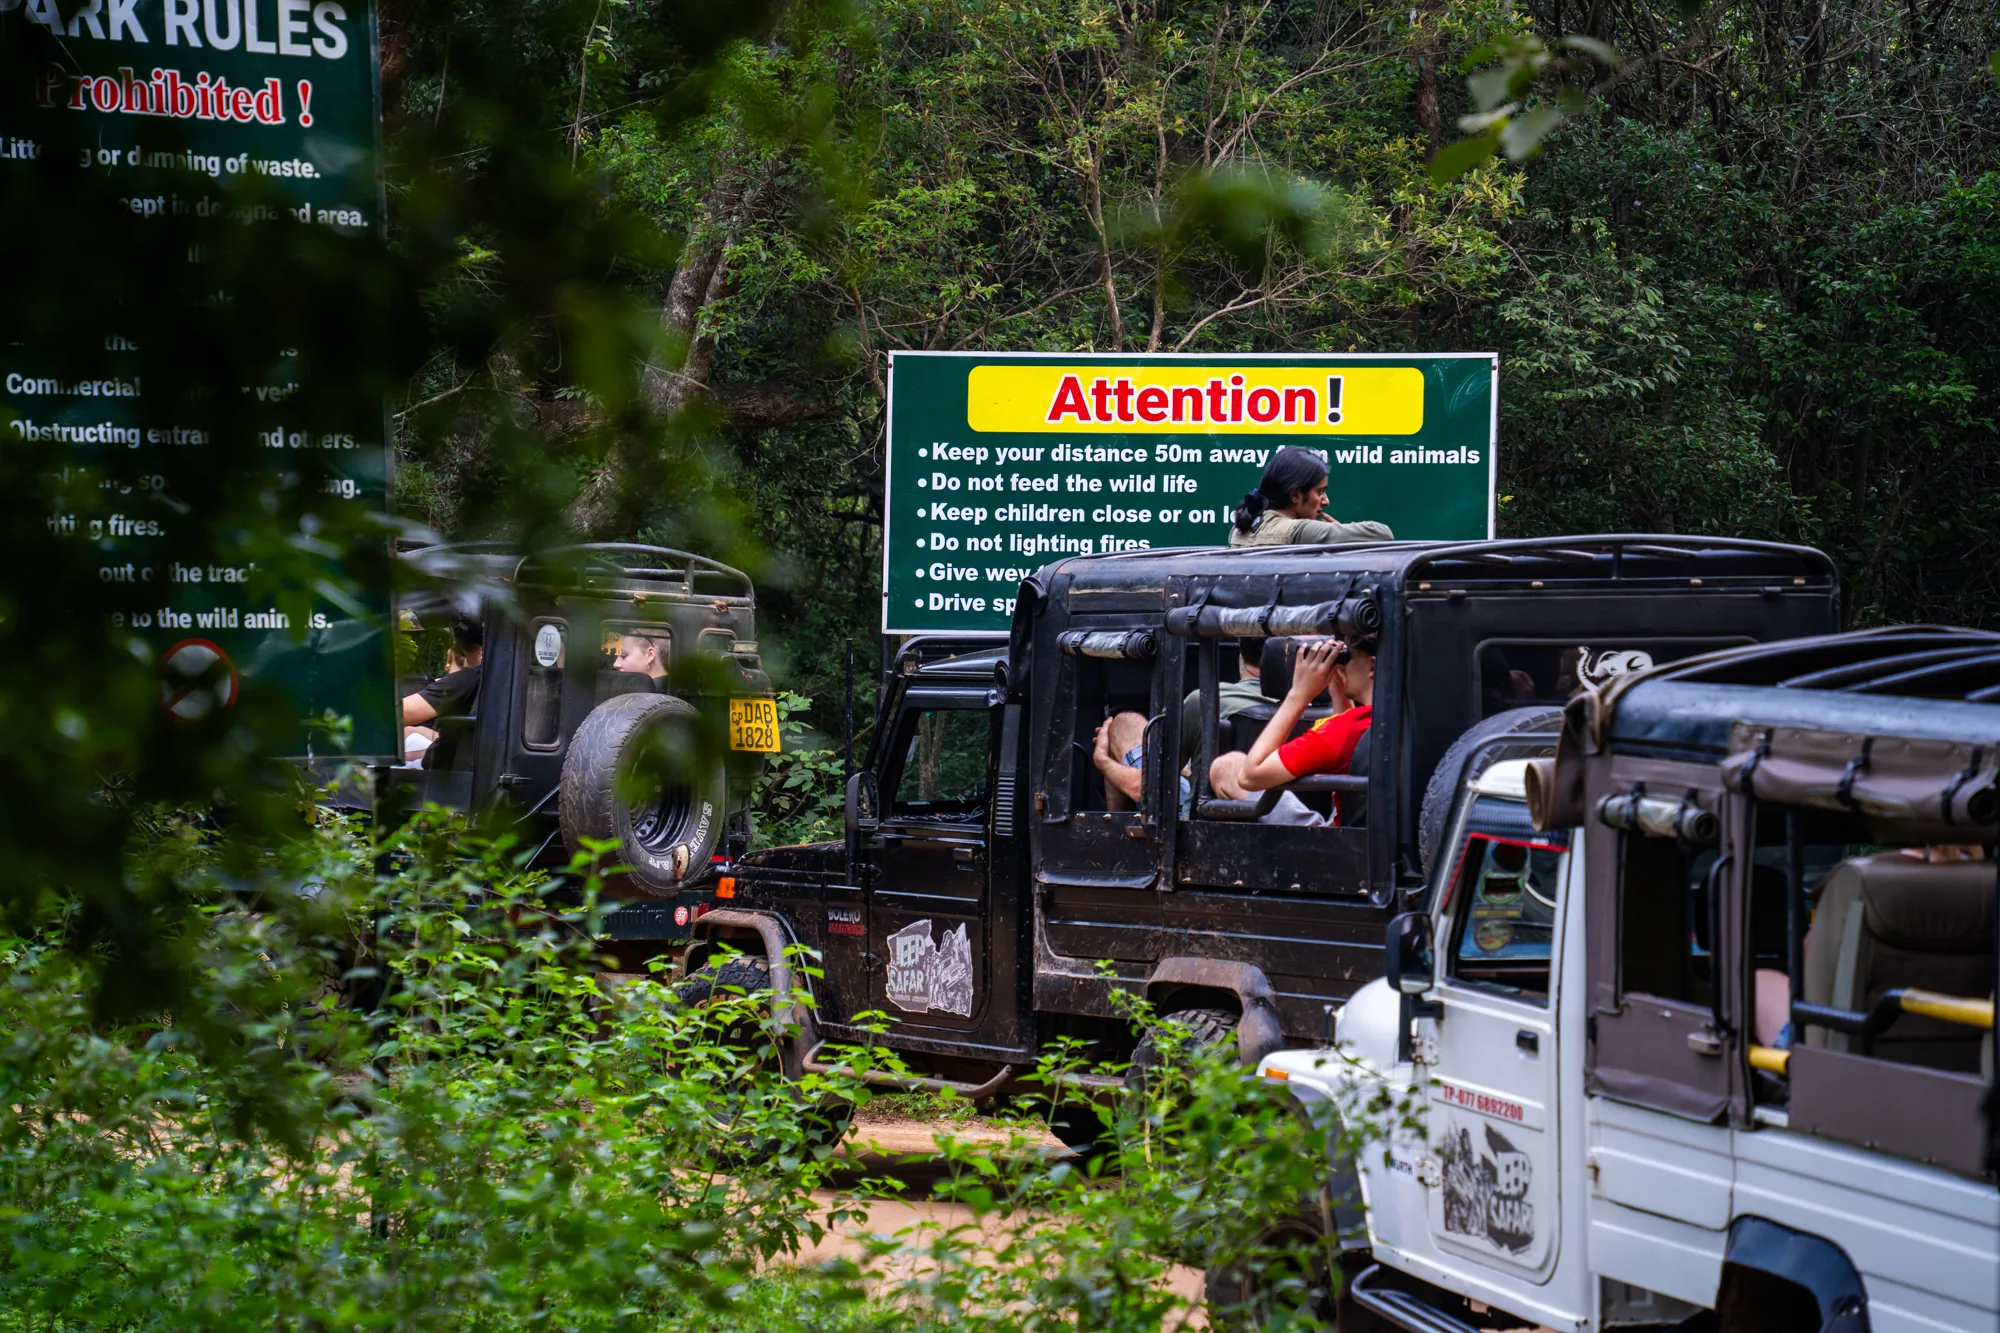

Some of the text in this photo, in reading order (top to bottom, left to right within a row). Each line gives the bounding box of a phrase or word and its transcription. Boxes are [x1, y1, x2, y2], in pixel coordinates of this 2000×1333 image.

[0, 0, 349, 60] ARK RULES
[36, 62, 285, 125] Prohibited
[97, 148, 122, 167] or
[225, 153, 248, 175] of
[252, 158, 322, 179] waste.
[317, 207, 369, 228] area.
[932, 442, 989, 465] Keep
[995, 447, 1045, 465] your
[1051, 443, 1148, 462] distance
[1155, 444, 1202, 462] 50m
[1209, 448, 1270, 467] away
[1335, 446, 1383, 464] wild
[1390, 445, 1480, 464] animals
[931, 472, 1198, 493] Do not feed the wild life
[108, 513, 166, 537] fires.
[930, 502, 988, 525] Keep
[994, 503, 1085, 522] children
[1092, 504, 1152, 523] close
[1158, 508, 1183, 523] or
[1188, 509, 1216, 524] on
[930, 532, 1151, 556] Do not lighting fires
[99, 562, 135, 583] out
[929, 562, 979, 581] Give
[985, 567, 1031, 586] wey
[928, 592, 986, 611] Drive
[156, 607, 192, 629] the
[196, 608, 239, 629] wild
[744, 702, 773, 725] DAB
[735, 727, 774, 748] 1828
[827, 909, 861, 924] BOLERO
[893, 934, 926, 968] JEEP
